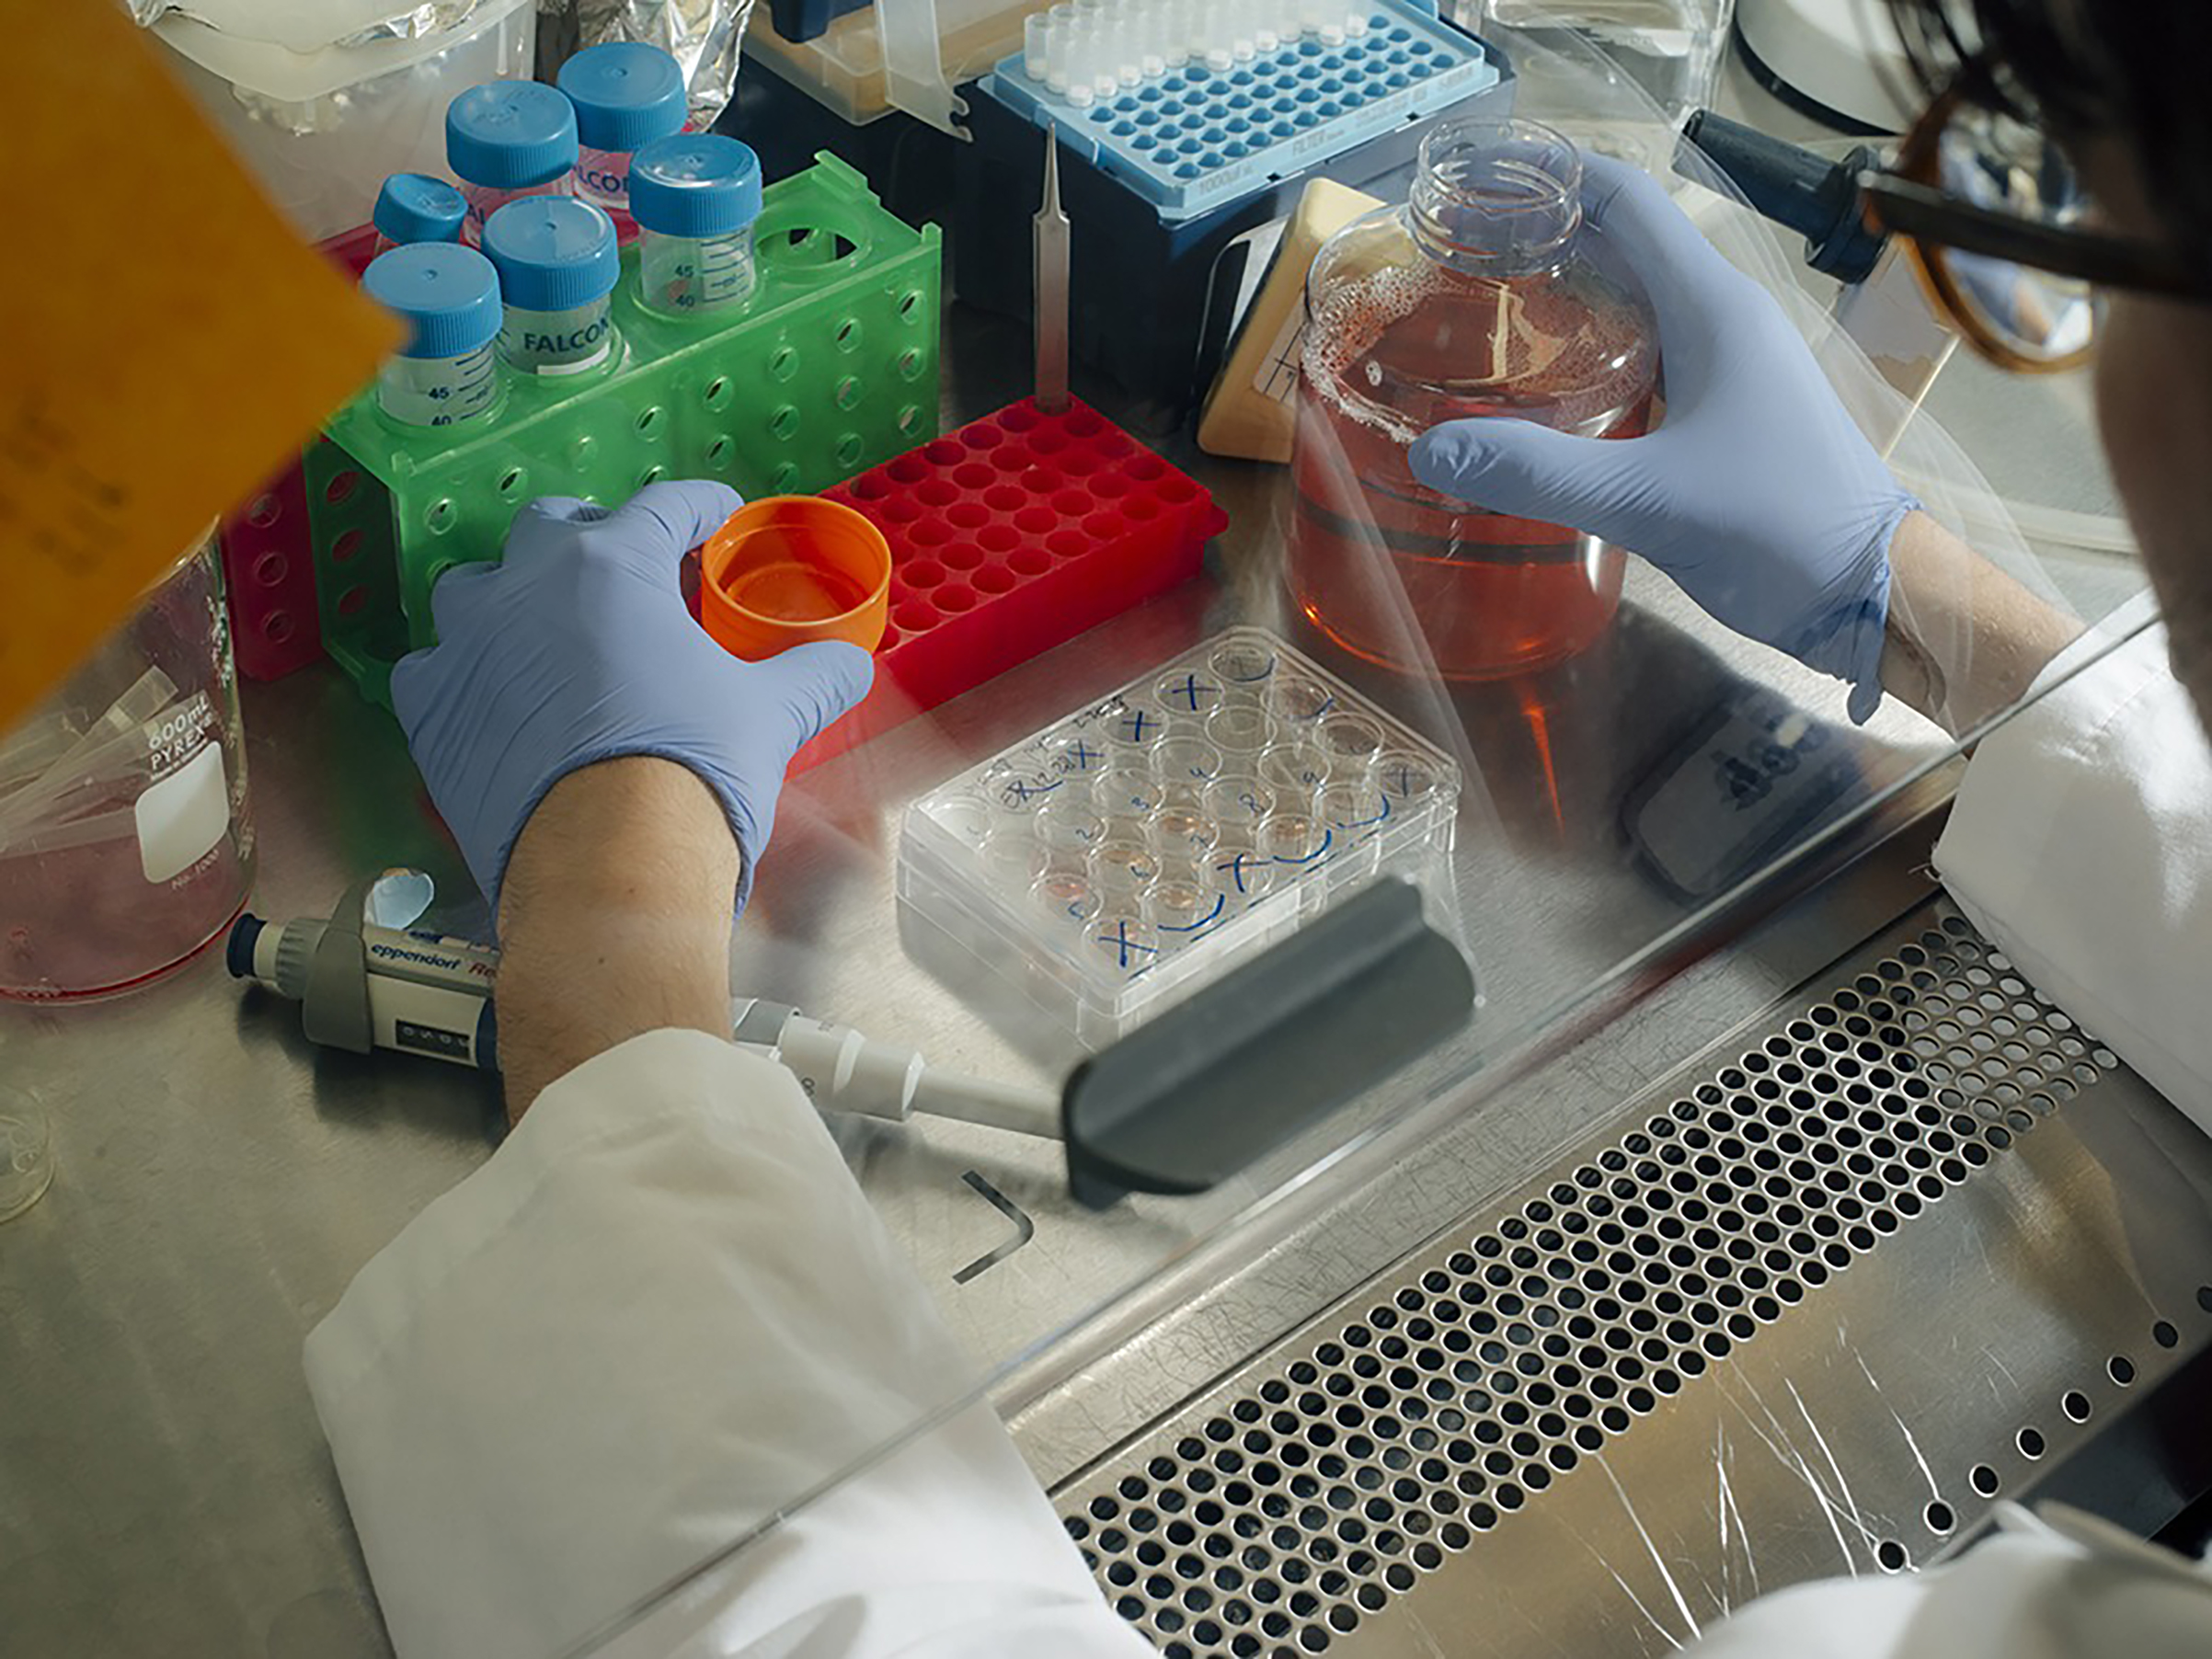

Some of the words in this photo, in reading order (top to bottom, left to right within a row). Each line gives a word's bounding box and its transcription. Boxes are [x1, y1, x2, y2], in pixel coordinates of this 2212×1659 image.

[675, 264, 694, 279] 45
[675, 293, 695, 308] 40
[523, 316, 610, 354] FALCON
[428, 387, 450, 400] 45
[371, 943, 461, 970] eppendorf
